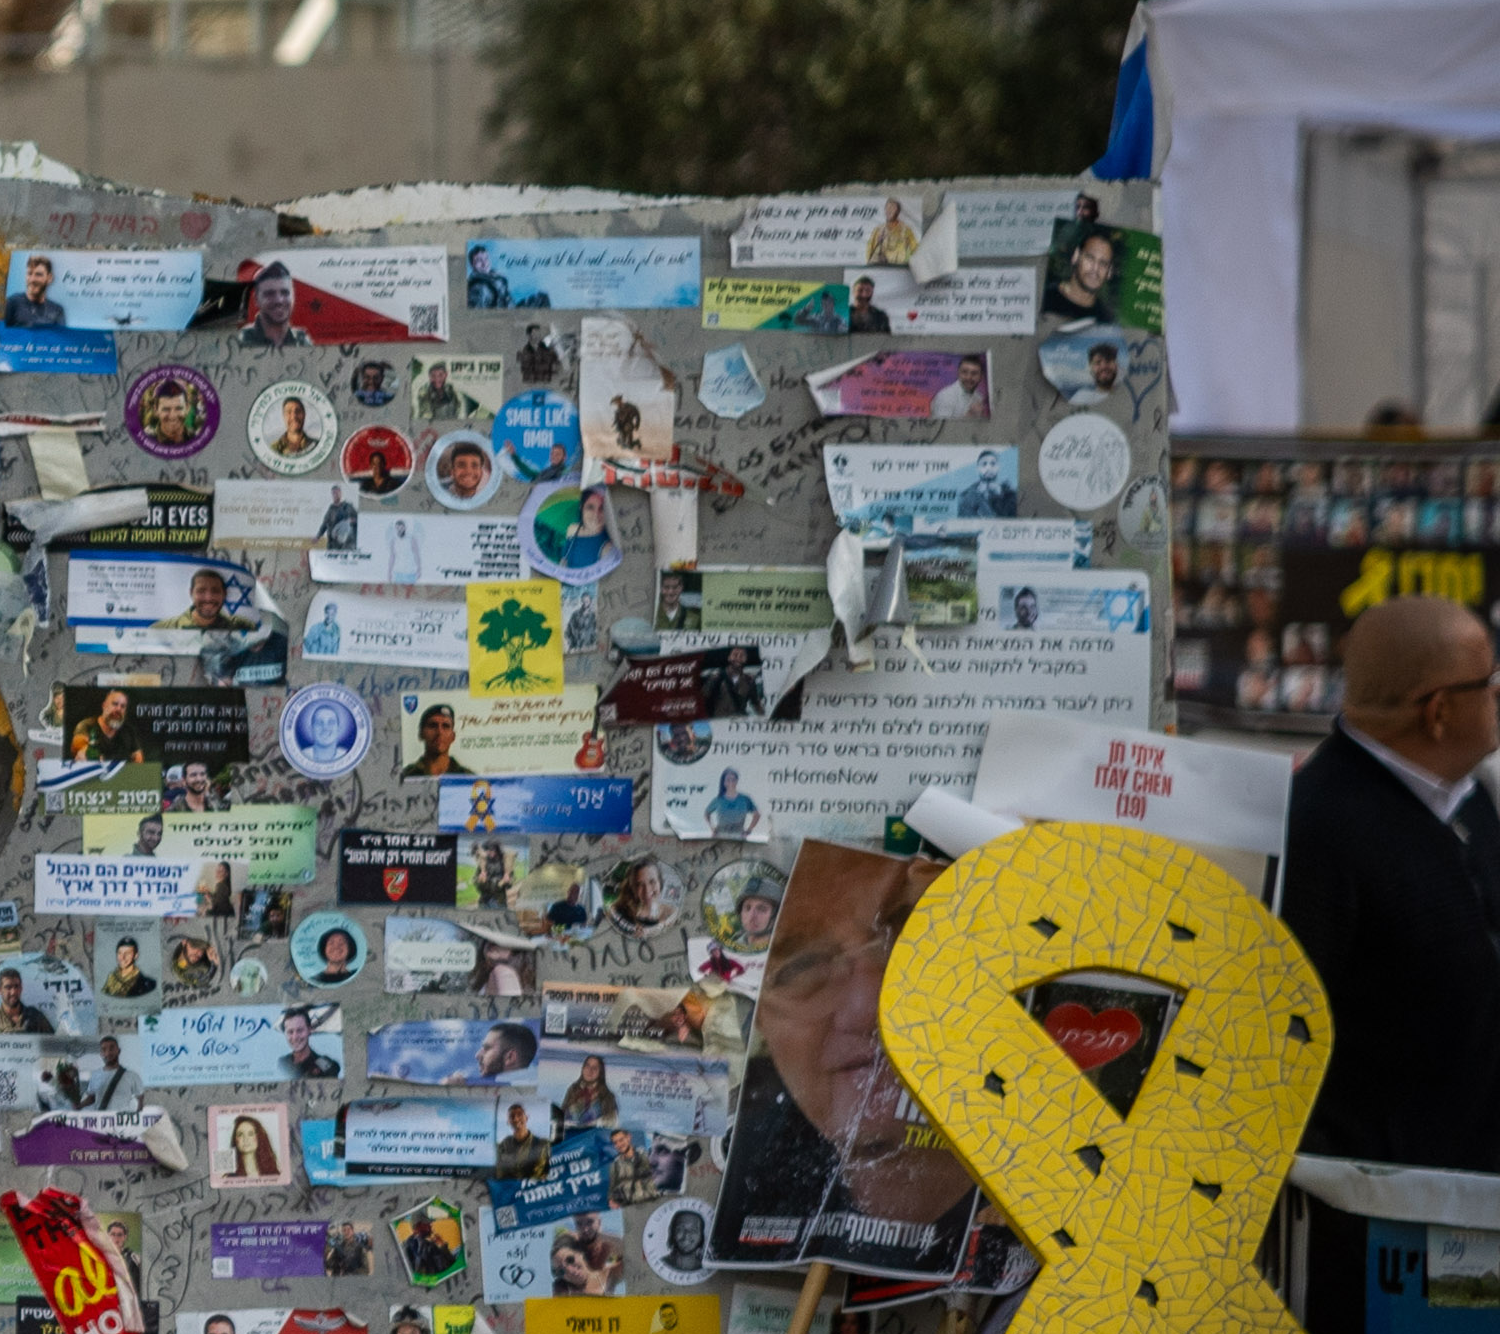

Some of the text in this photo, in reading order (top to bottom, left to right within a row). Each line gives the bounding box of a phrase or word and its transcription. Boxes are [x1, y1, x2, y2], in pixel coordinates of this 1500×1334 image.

[505, 407, 571, 427] SMILE LIKE
[522, 429, 554, 448] OMRI
[965, 637, 1033, 651] המציאות
[1039, 638, 1062, 651] את
[884, 660, 907, 674] עם
[968, 655, 1087, 677] במקביל לתקווה
[882, 695, 918, 708] מסר
[922, 692, 975, 709] ולכתוב
[981, 695, 1046, 710] במנהרה
[1053, 692, 1097, 711] לעבור
[1098, 695, 1133, 714] ניתן
[802, 720, 824, 733] את
[801, 743, 828, 756] סדר
[834, 743, 880, 757] בראש
[887, 744, 956, 758] החטופים
[1108, 739, 1166, 769] איתי חן
[1094, 765, 1173, 797] ITAY CHEN
[117, 788, 160, 805] הטוב
[1116, 793, 1147, 821] (19)
[167, 821, 213, 833] לאחר
[219, 820, 258, 832] טובה
[193, 835, 293, 847] תוביל לעולם
[46, 859, 91, 876] הגבול
[95, 863, 118, 877] הם
[101, 879, 129, 897] דרך
[137, 880, 179, 898] והדרך
[43, 978, 83, 996] בודי
[234, 1016, 272, 1042] תהיו
